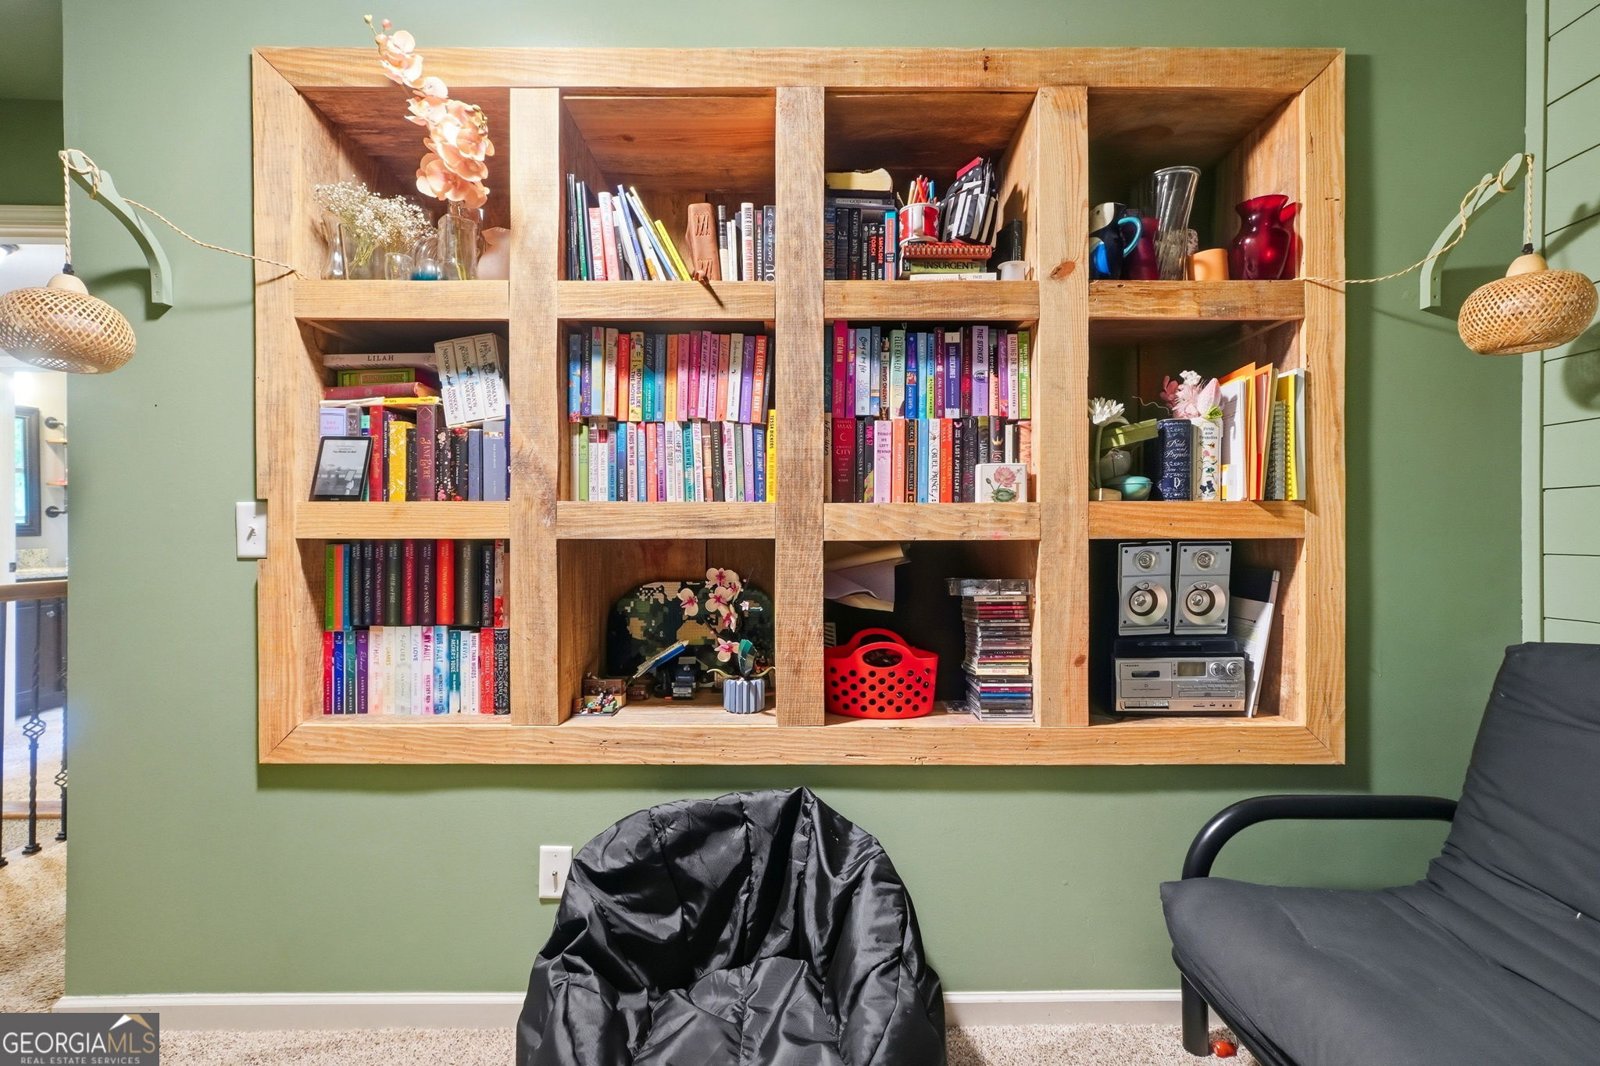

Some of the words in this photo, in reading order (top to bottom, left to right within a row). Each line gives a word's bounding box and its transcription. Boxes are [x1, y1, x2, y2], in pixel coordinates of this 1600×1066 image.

[894, 336, 903, 348] ELLE
[976, 329, 984, 340] THE
[756, 339, 765, 355] BOOK
[836, 336, 845, 353] DREAM
[976, 340, 984, 364] STRIKER
[756, 355, 764, 376] LOVERS
[836, 354, 844, 362] ON
[894, 349, 903, 372] KENNEDY
[754, 395, 762, 412] HENRY
[930, 470, 939, 494] PRINCE
[424, 634, 431, 643] MY
[436, 633, 444, 644] OUR
